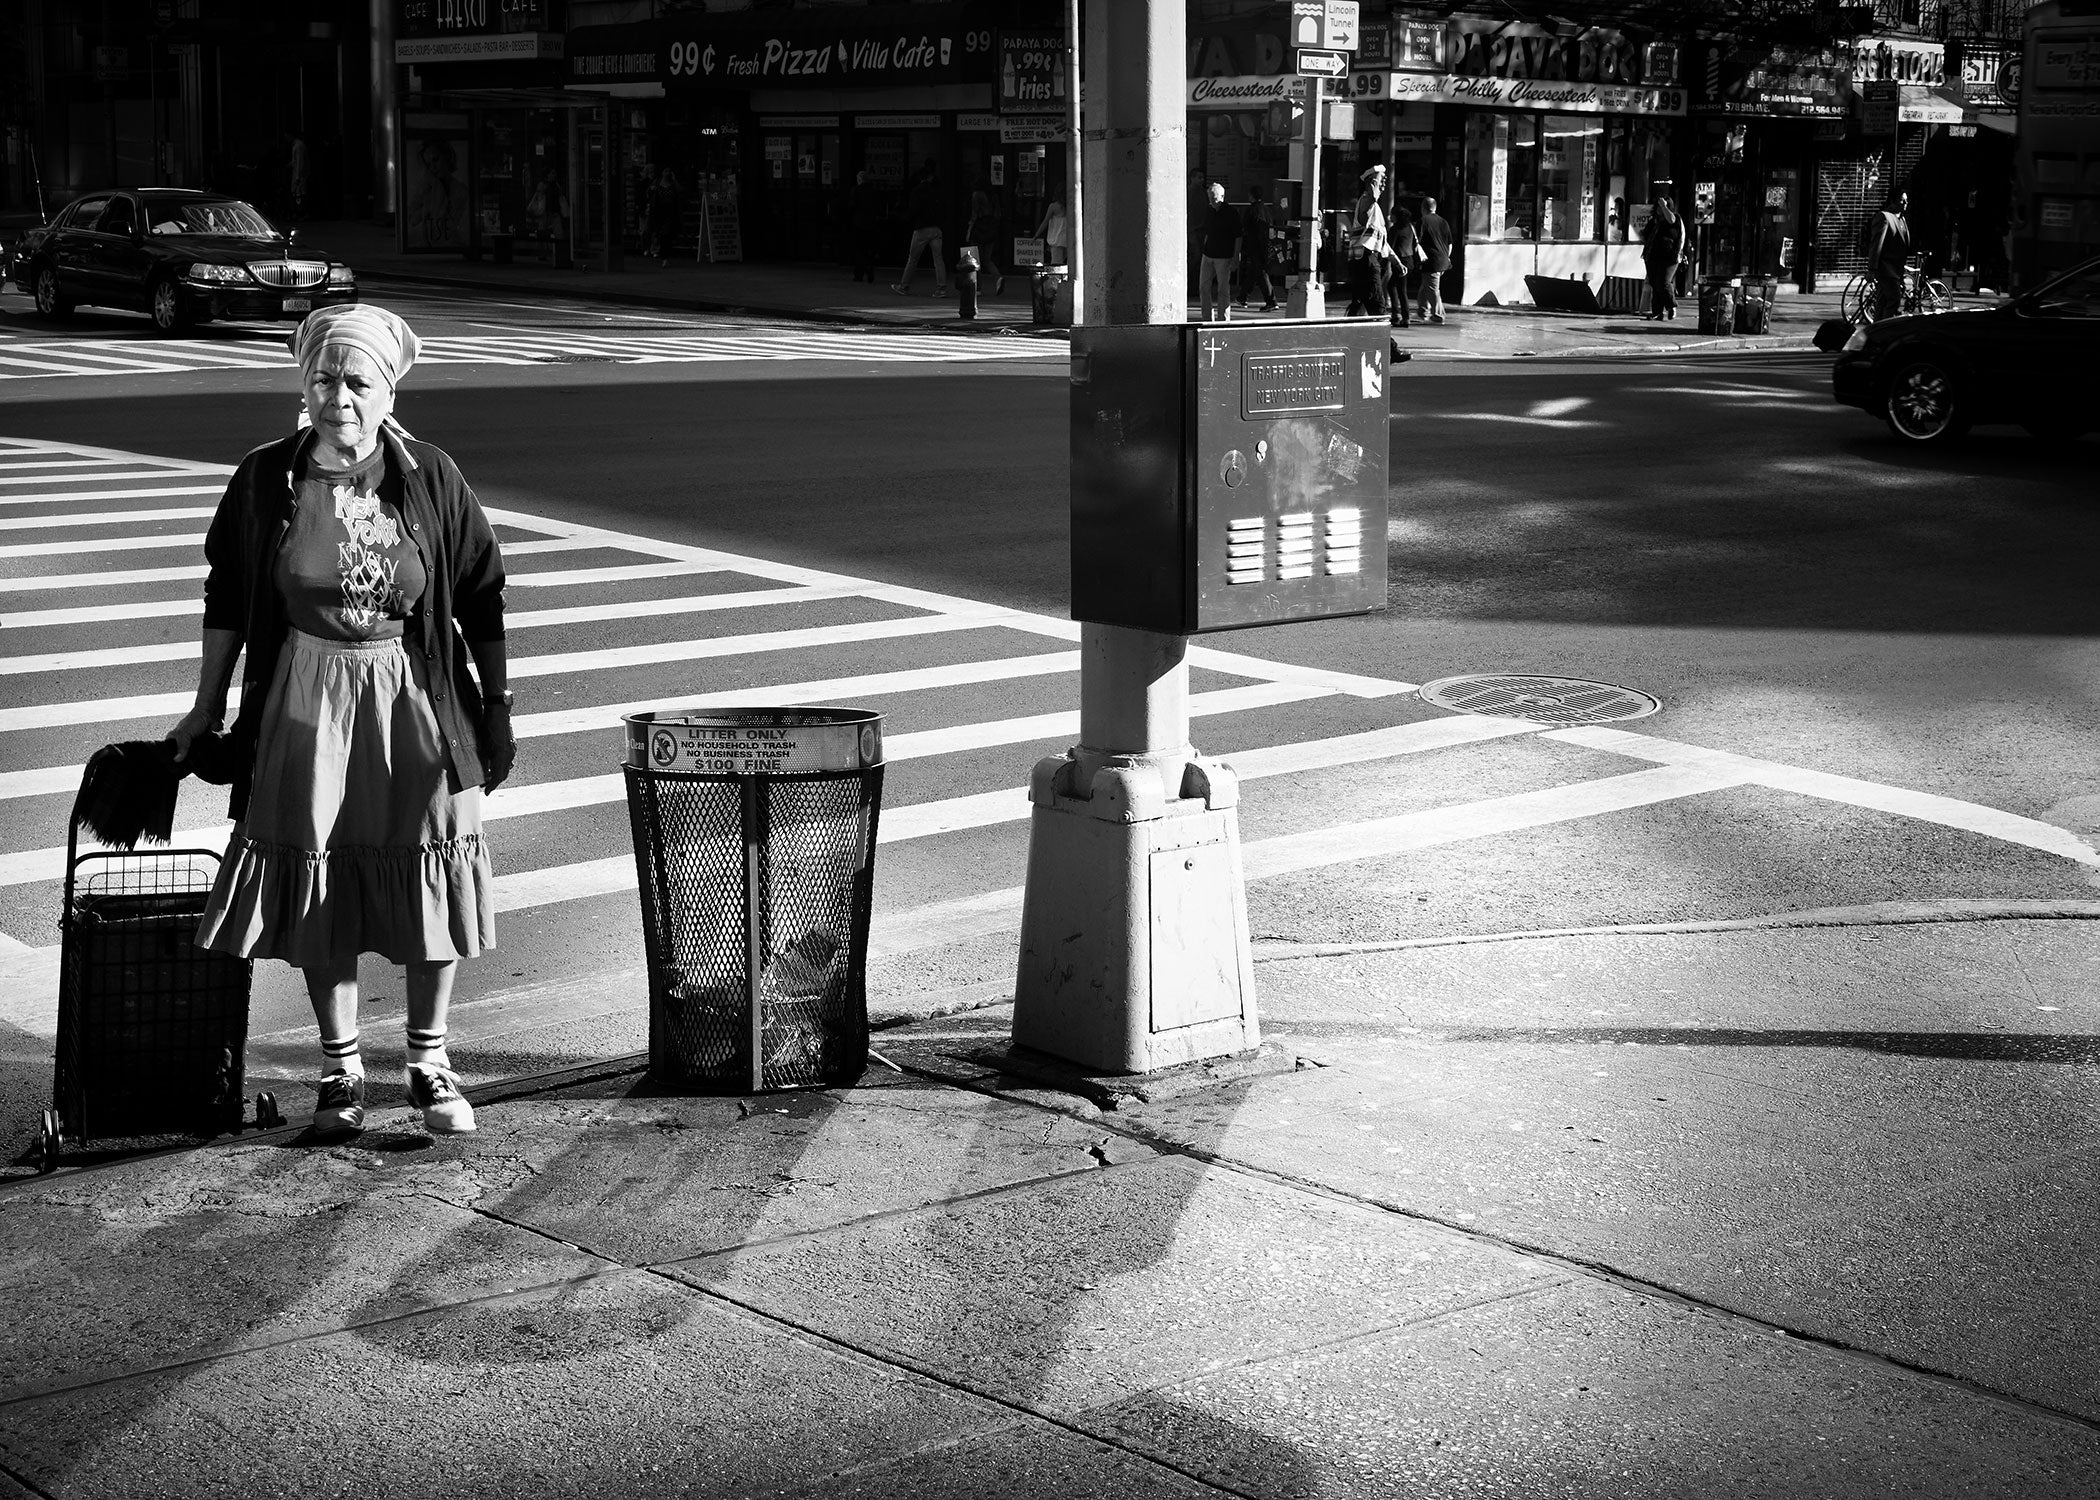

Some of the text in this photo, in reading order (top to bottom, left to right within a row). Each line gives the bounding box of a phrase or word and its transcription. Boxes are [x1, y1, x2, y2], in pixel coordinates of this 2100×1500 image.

[1328, 4, 1356, 15] Lincoln
[1330, 17, 1354, 28] Tunnel
[1003, 38, 1063, 49] PAPAYA DOG
[669, 36, 936, 76] 99¢ Fresh Pizza Villa Cafe
[1446, 31, 1637, 83] PAPAYA DOG
[1304, 57, 1341, 69] ONE WAY
[1019, 74, 1051, 100] Fries
[1191, 78, 1284, 102] Cheesesteak
[1398, 77, 1597, 104] Special! Philly Cheesesteak
[1634, 90, 1682, 111] $4.99
[1771, 95, 1784, 103] Men
[1725, 102, 1740, 112] 578
[1741, 103, 1754, 113] 9th
[960, 118, 981, 127] LARGE
[1006, 118, 1025, 127] FREE
[1026, 118, 1040, 126] HOT
[1042, 118, 1056, 126] DOG
[1705, 155, 1725, 166] ATM
[1697, 183, 1713, 191] ATM
[1251, 361, 1343, 380] TRAFFIC CONTROL
[1256, 385, 1337, 405] NEW YORK CITY
[688, 729, 788, 740] LITTER ONLY
[681, 741, 796, 750] NO HOUSEHOLD TRASH
[686, 750, 790, 759] NO BUSINESS TRASH
[694, 759, 781, 770] $100 FINE
